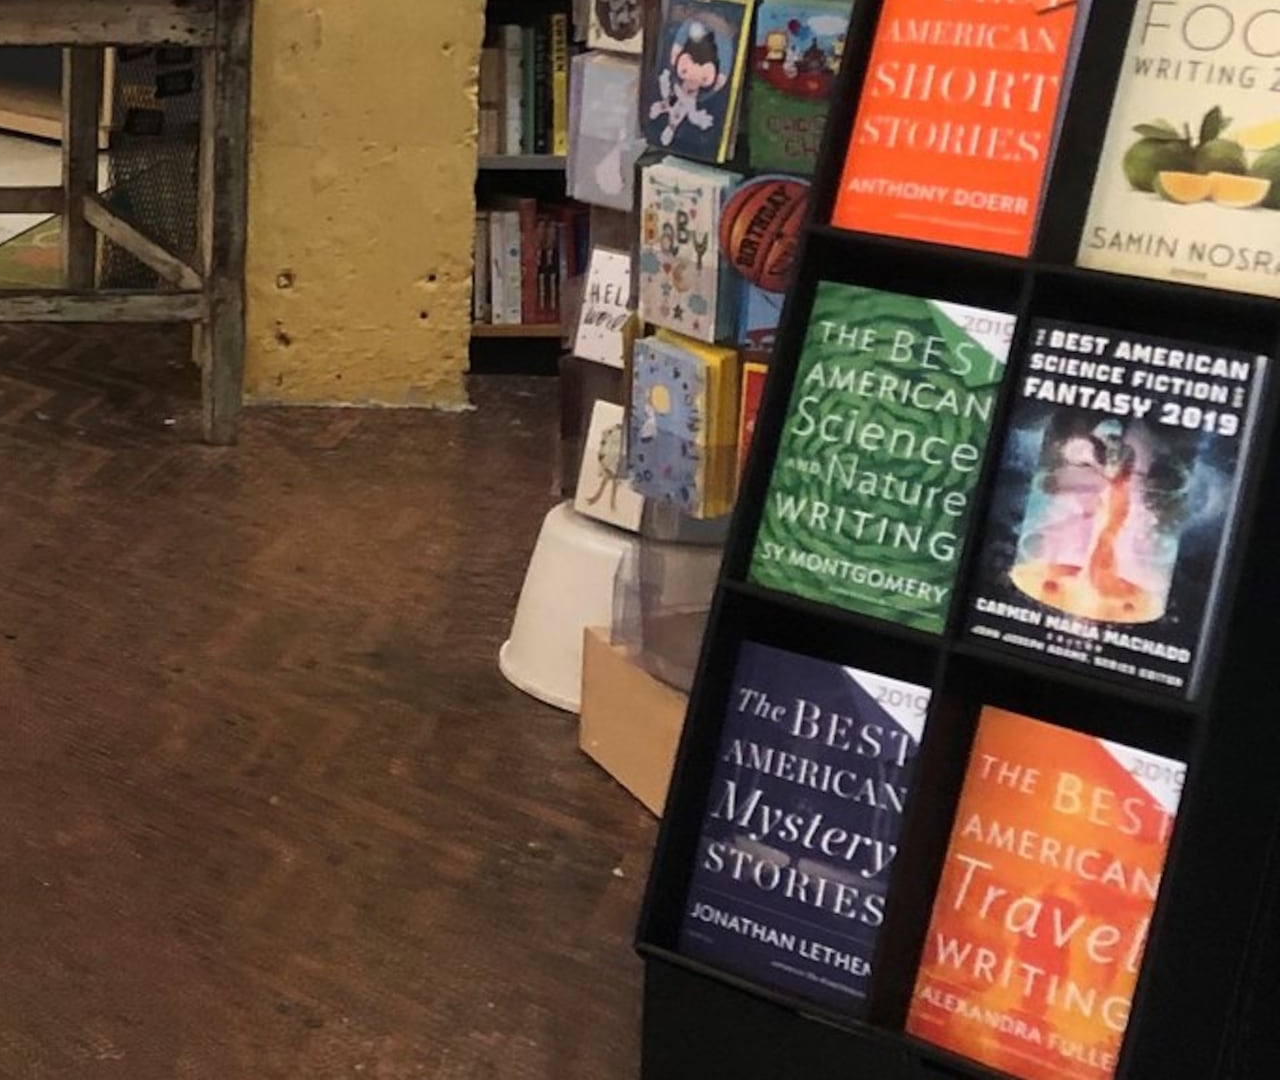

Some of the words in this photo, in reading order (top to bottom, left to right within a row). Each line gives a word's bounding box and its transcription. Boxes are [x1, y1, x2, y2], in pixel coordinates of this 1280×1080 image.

[883, 18, 1057, 54] AMERICAN
[871, 60, 1060, 113] SHORT
[1132, 56, 1256, 90] WRITING
[859, 115, 1041, 163] STORIES
[736, 184, 792, 268] BIRTHDAY
[848, 177, 951, 202] ANTHONY
[953, 188, 1029, 215] DOERR
[1090, 226, 1178, 259] SAMIN
[590, 282, 630, 309] HEL
[819, 321, 877, 352] THE
[1049, 329, 1110, 356] BEST
[1114, 341, 1251, 382] AMERICAN
[804, 361, 993, 422] AMERICAN
[1023, 376, 1152, 419] FANTASY
[1158, 401, 1239, 437] 2019
[1029, 352, 1126, 385] SCIENCE
[1131, 370, 1229, 404] FICTION
[791, 395, 979, 473] Science
[787, 457, 820, 476] AND
[826, 453, 968, 517] Nature
[774, 492, 957, 562] WRITING
[761, 542, 787, 561] SY
[789, 550, 950, 604] MONTGOMERY
[975, 596, 1043, 626] CARMEN
[1046, 614, 1101, 640] MARIA
[1102, 629, 1192, 664] MACHADO
[738, 687, 787, 723] The
[791, 698, 910, 768] BEST
[875, 684, 930, 719] 2019
[722, 738, 908, 815] AMERICAN
[982, 753, 1040, 795] THE
[1052, 770, 1173, 845] BEST
[710, 780, 898, 880] Mystery
[962, 812, 1159, 900] AMERICAN
[703, 840, 887, 928] STORIES
[953, 853, 1151, 974] Travel
[690, 901, 796, 953] JONATHAN
[935, 932, 1133, 1033] WRITING
[920, 985, 1042, 1042] ALEXANDRA
